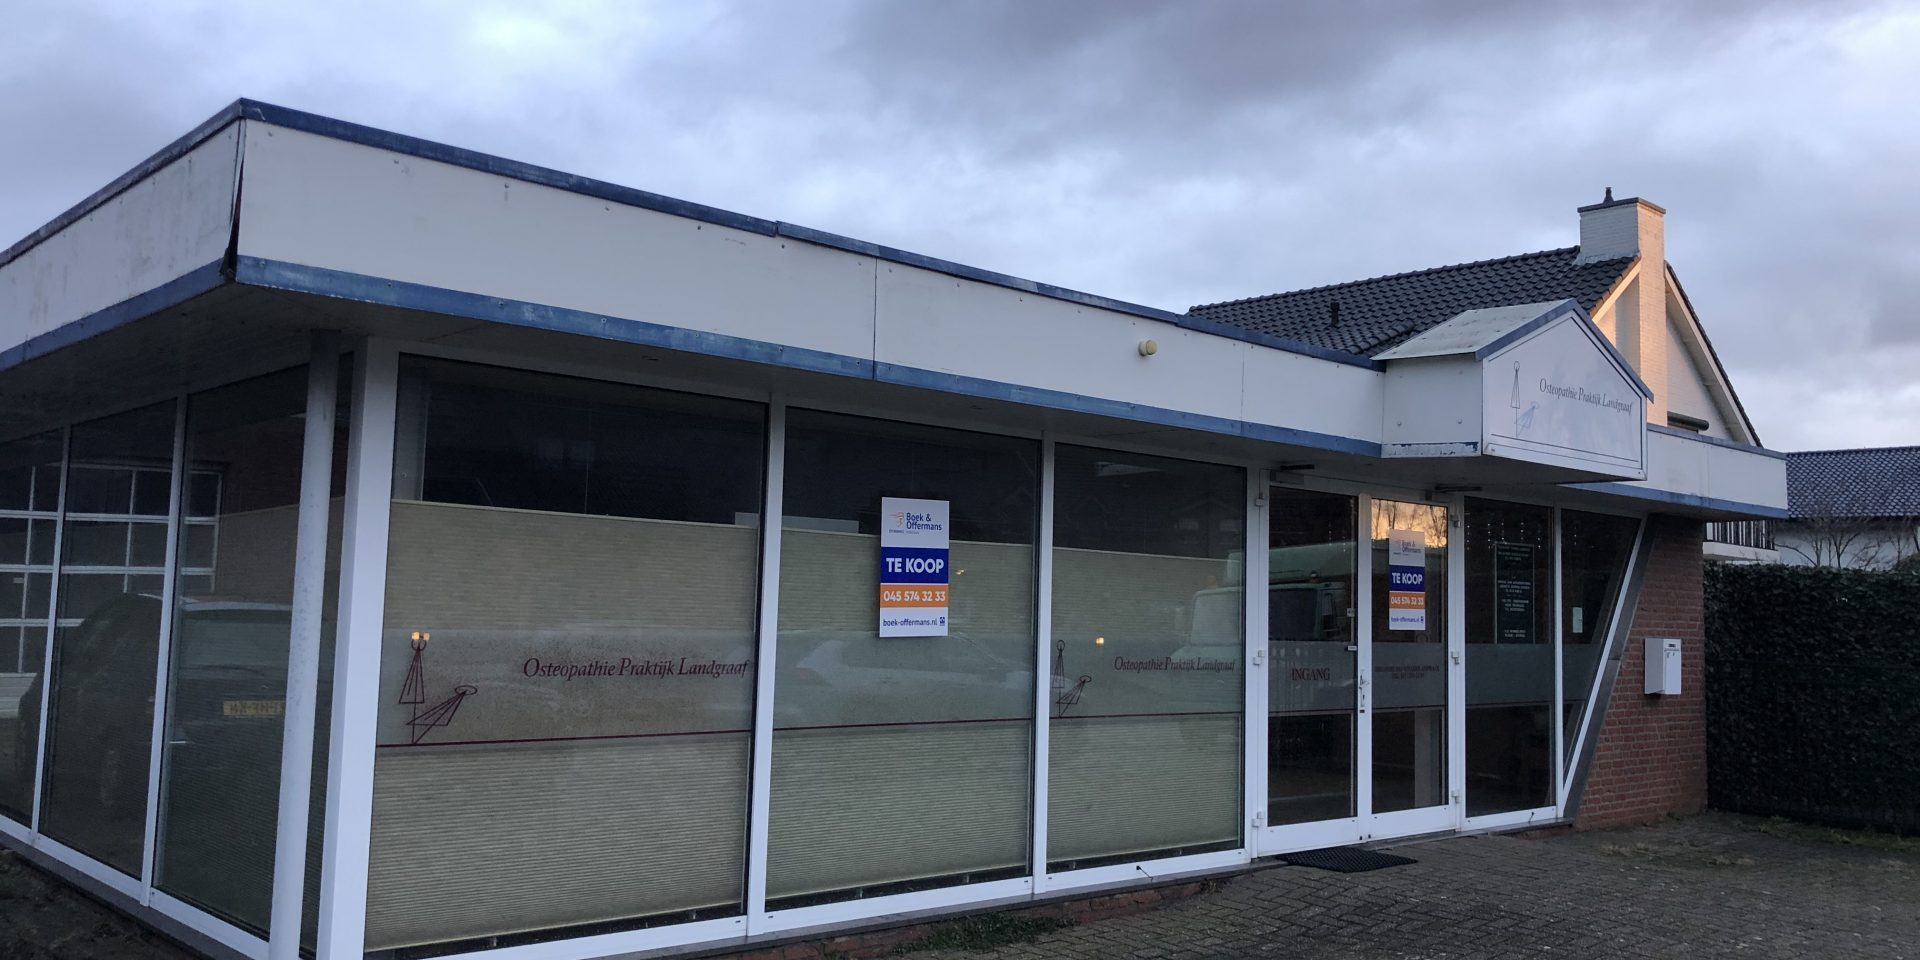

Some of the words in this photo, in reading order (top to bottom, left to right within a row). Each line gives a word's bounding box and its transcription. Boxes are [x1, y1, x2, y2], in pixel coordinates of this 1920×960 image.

[1539, 378, 1578, 399] Osteopathie
[1578, 387, 1602, 407] Praktijk
[1602, 393, 1633, 416] Landgraaf
[906, 512, 924, 522] Boek
[926, 513, 932, 522] &
[906, 521, 942, 531] Offermans
[886, 557, 902, 573] TE
[905, 558, 944, 574] KOOP
[1392, 573, 1401, 584] TE
[1402, 573, 1423, 584] KOOP
[883, 591, 901, 602] 045
[904, 591, 920, 602] 574
[922, 591, 933, 602] 32
[935, 591, 946, 602] 33
[883, 617, 938, 627] boek-offermans.nl
[523, 657, 616, 682] Osteopathie
[618, 657, 675, 680] Praktijk
[677, 657, 750, 678] Landgraaf
[1114, 656, 1164, 674] Osteopathie
[1164, 657, 1196, 673] Praktijk
[1196, 657, 1235, 673] Landgraaf
[1291, 667, 1330, 680] INGANG
